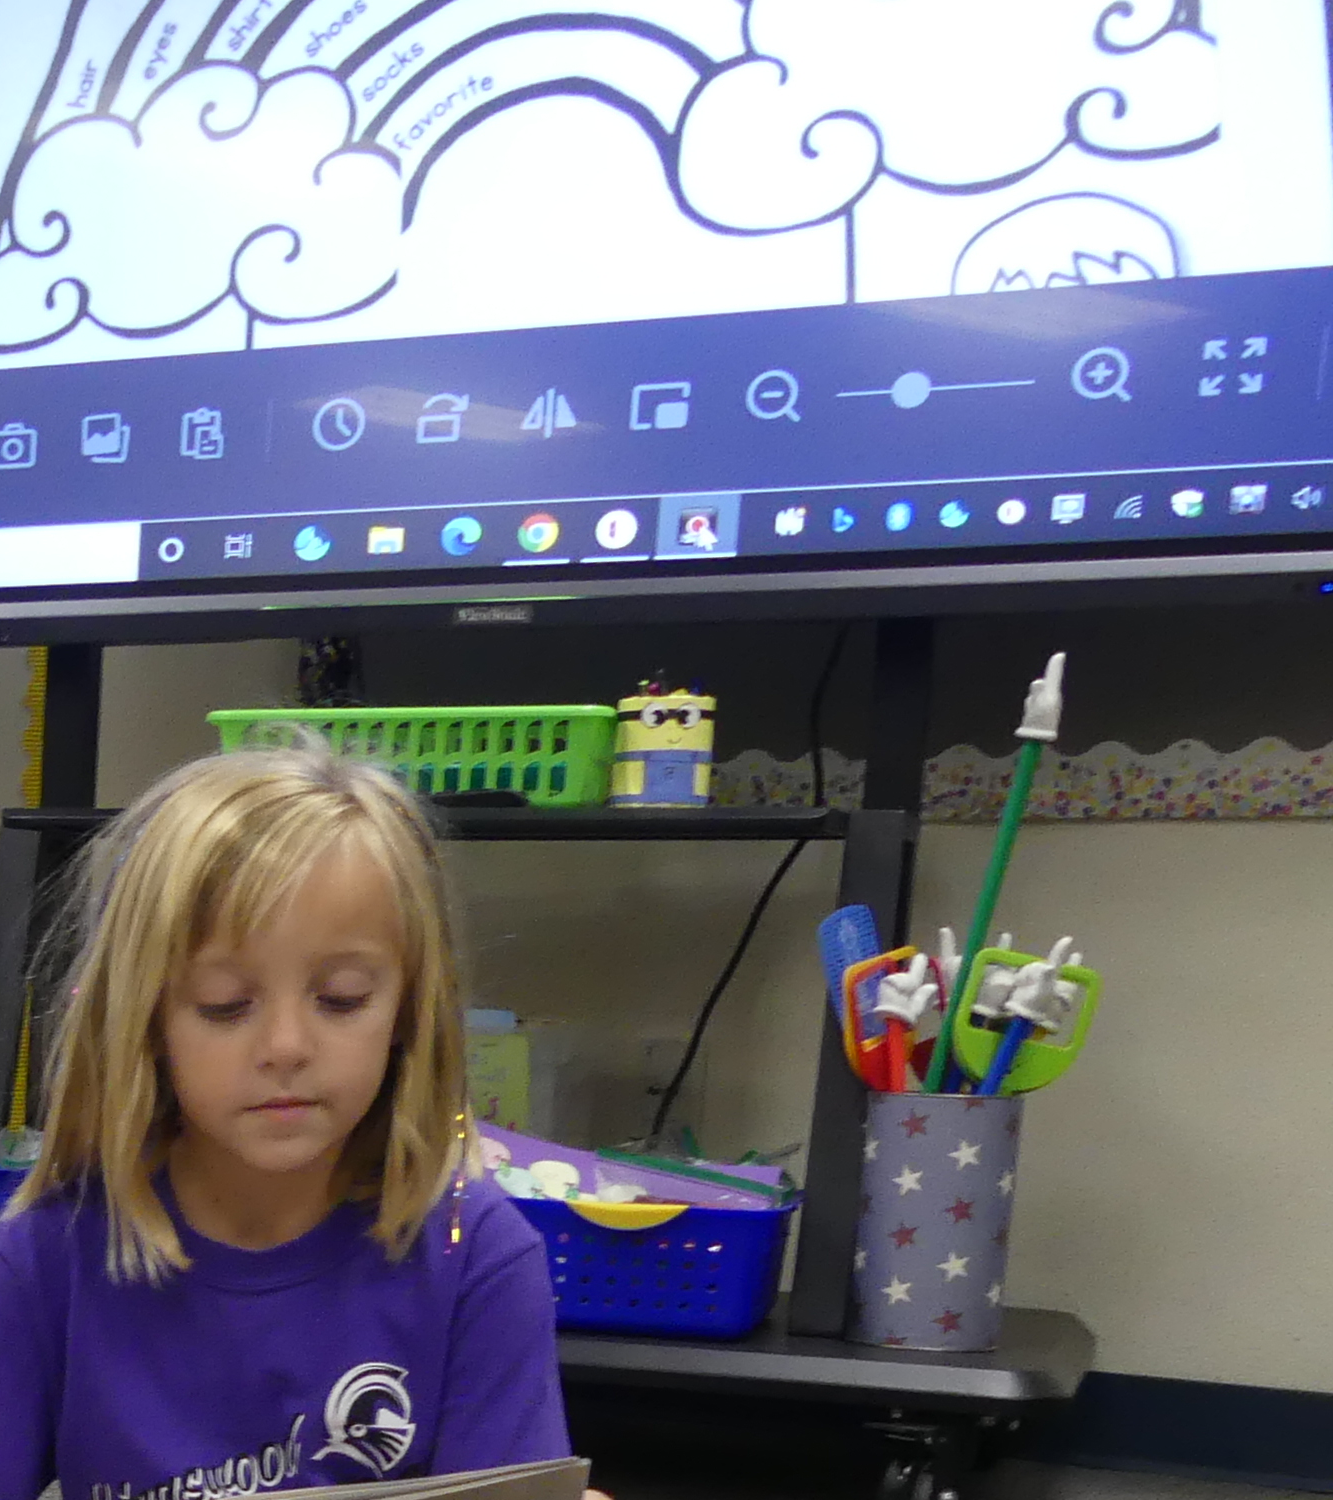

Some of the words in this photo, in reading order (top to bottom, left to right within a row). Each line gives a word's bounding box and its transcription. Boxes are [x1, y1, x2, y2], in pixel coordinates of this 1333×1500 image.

[143, 22, 178, 81] eyes
[227, 0, 273, 51] shirt
[305, 0, 368, 58] shoes
[66, 58, 98, 109] hair
[362, 40, 425, 102] socks
[392, 73, 495, 152] favorite
